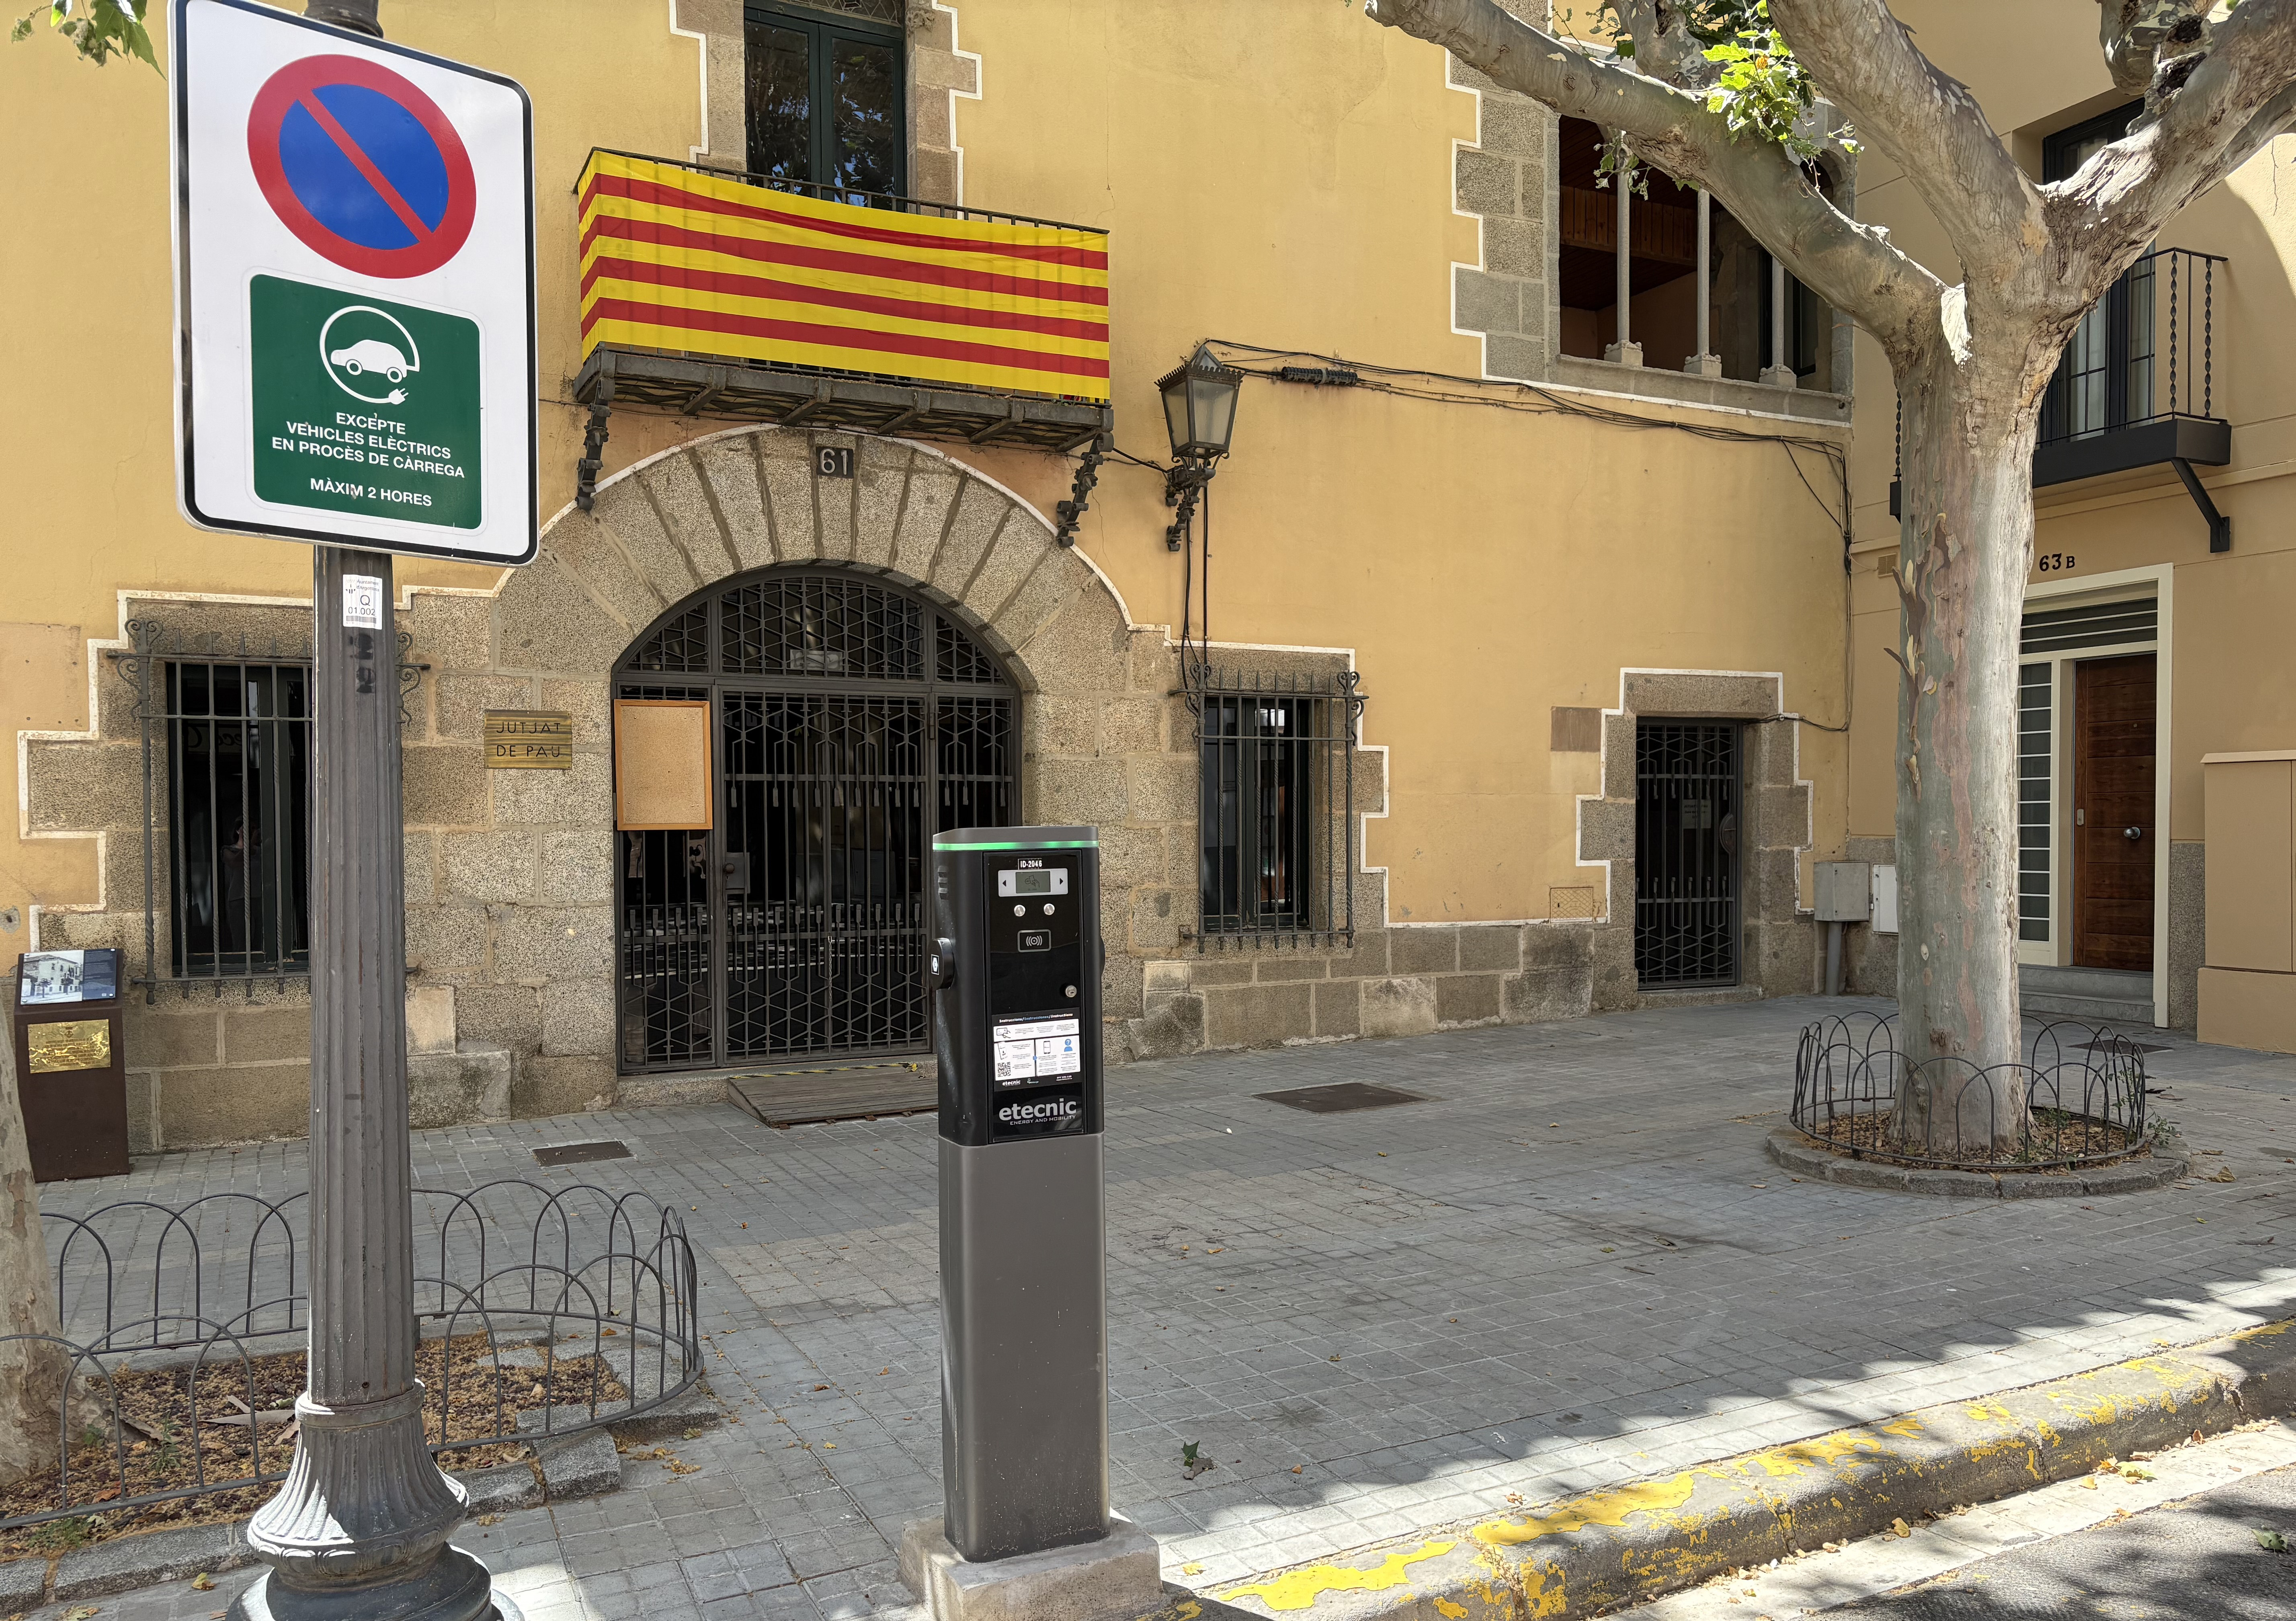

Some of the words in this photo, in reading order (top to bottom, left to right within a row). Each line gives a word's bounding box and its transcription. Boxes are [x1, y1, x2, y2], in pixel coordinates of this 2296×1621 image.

[336, 412, 406, 435] EXCEPTE
[286, 421, 364, 445] VEHICLES
[369, 435, 451, 459] ELÈCTRICS
[272, 436, 294, 451] EN
[299, 441, 365, 462] PROCÈS
[369, 452, 389, 466] DE
[393, 455, 465, 478] CÀRREGA
[820, 448, 849, 476] 61
[310, 477, 363, 497] MÀXIM
[367, 487, 377, 499] 2
[380, 488, 432, 507] HORES
[348, 606, 375, 616] 01.002
[360, 595, 371, 606] Q
[496, 722, 561, 734] JUTJAT
[496, 745, 516, 757] DE
[527, 745, 560, 757] PAU
[998, 1098, 1077, 1121] etecnic
